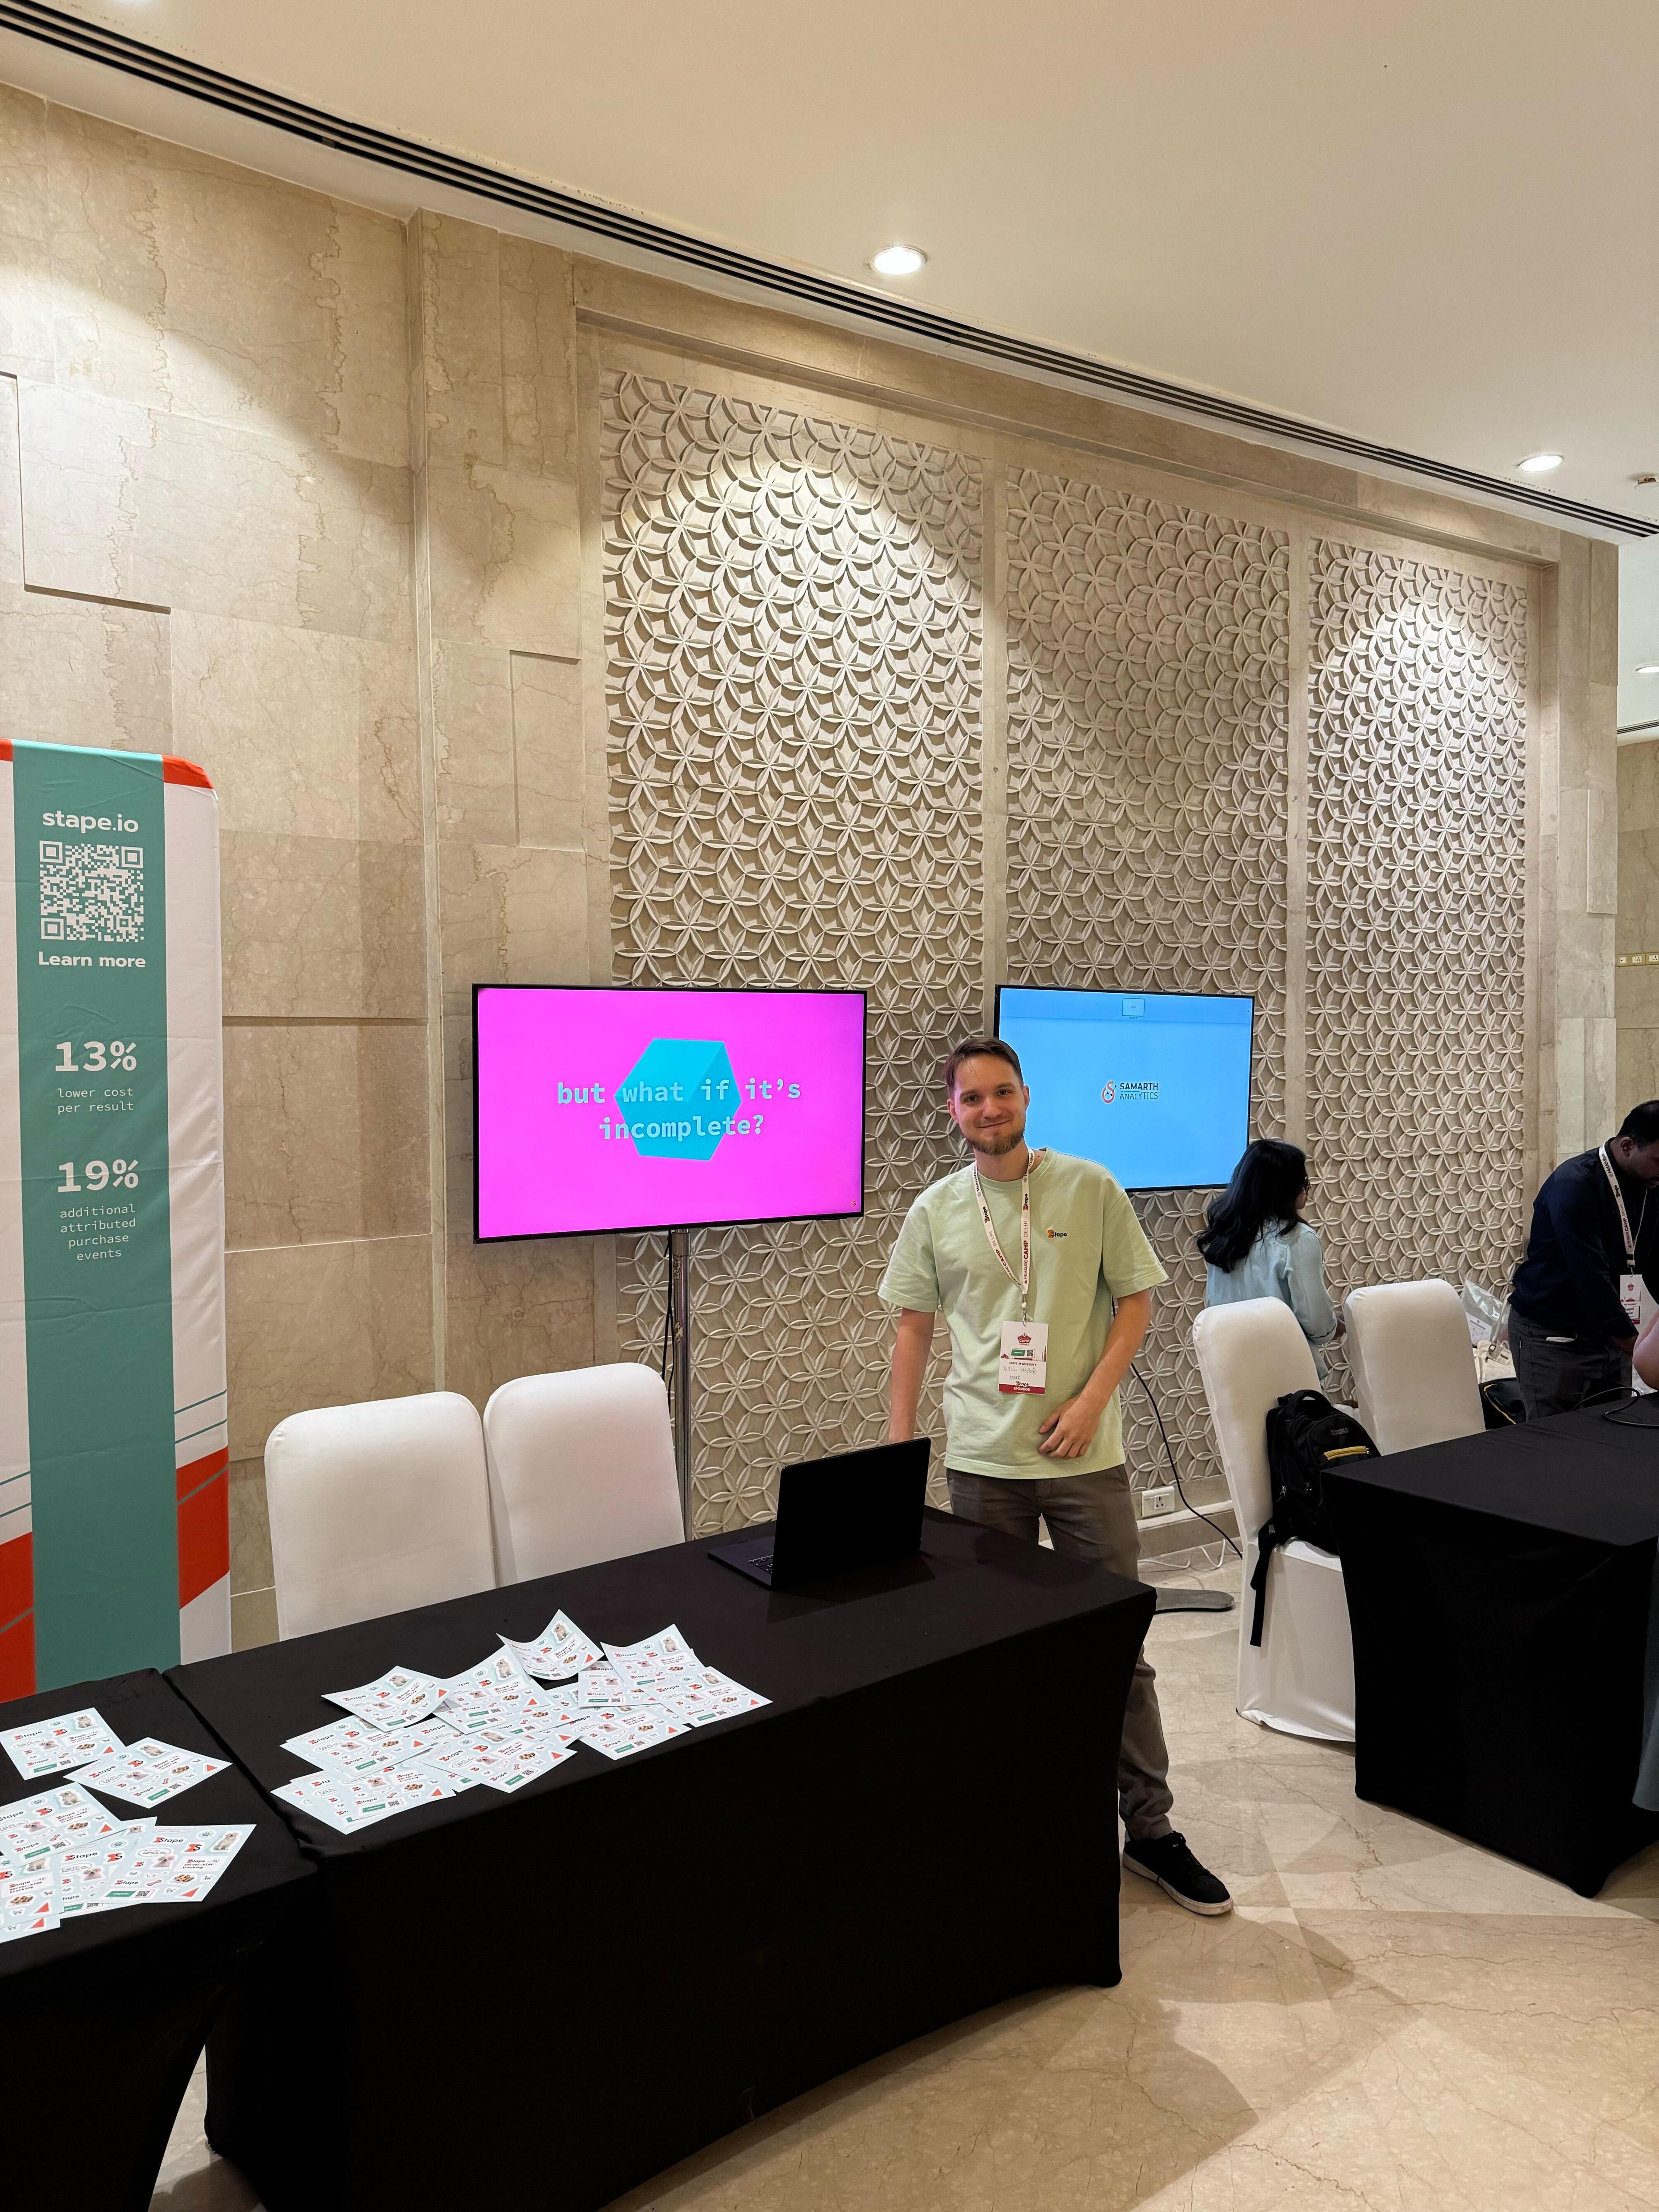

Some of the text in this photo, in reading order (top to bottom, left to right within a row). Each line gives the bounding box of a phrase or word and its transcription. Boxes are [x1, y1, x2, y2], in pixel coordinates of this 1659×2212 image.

[43, 810, 139, 833] stape.io
[39, 951, 146, 968] Learn more
[55, 1041, 137, 1071] 13%
[58, 1087, 133, 1098] lower cost
[558, 1082, 605, 1104] but
[623, 1082, 683, 1102] what
[702, 1079, 729, 1100] if
[58, 1101, 133, 1115] per result
[600, 1115, 764, 1142] incomplete?
[58, 1159, 139, 1192] 19%
[60, 1204, 135, 1218] additional
[60, 1218, 136, 1233] attributed
[69, 1235, 129, 1249] purchase
[76, 1249, 121, 1261] events
